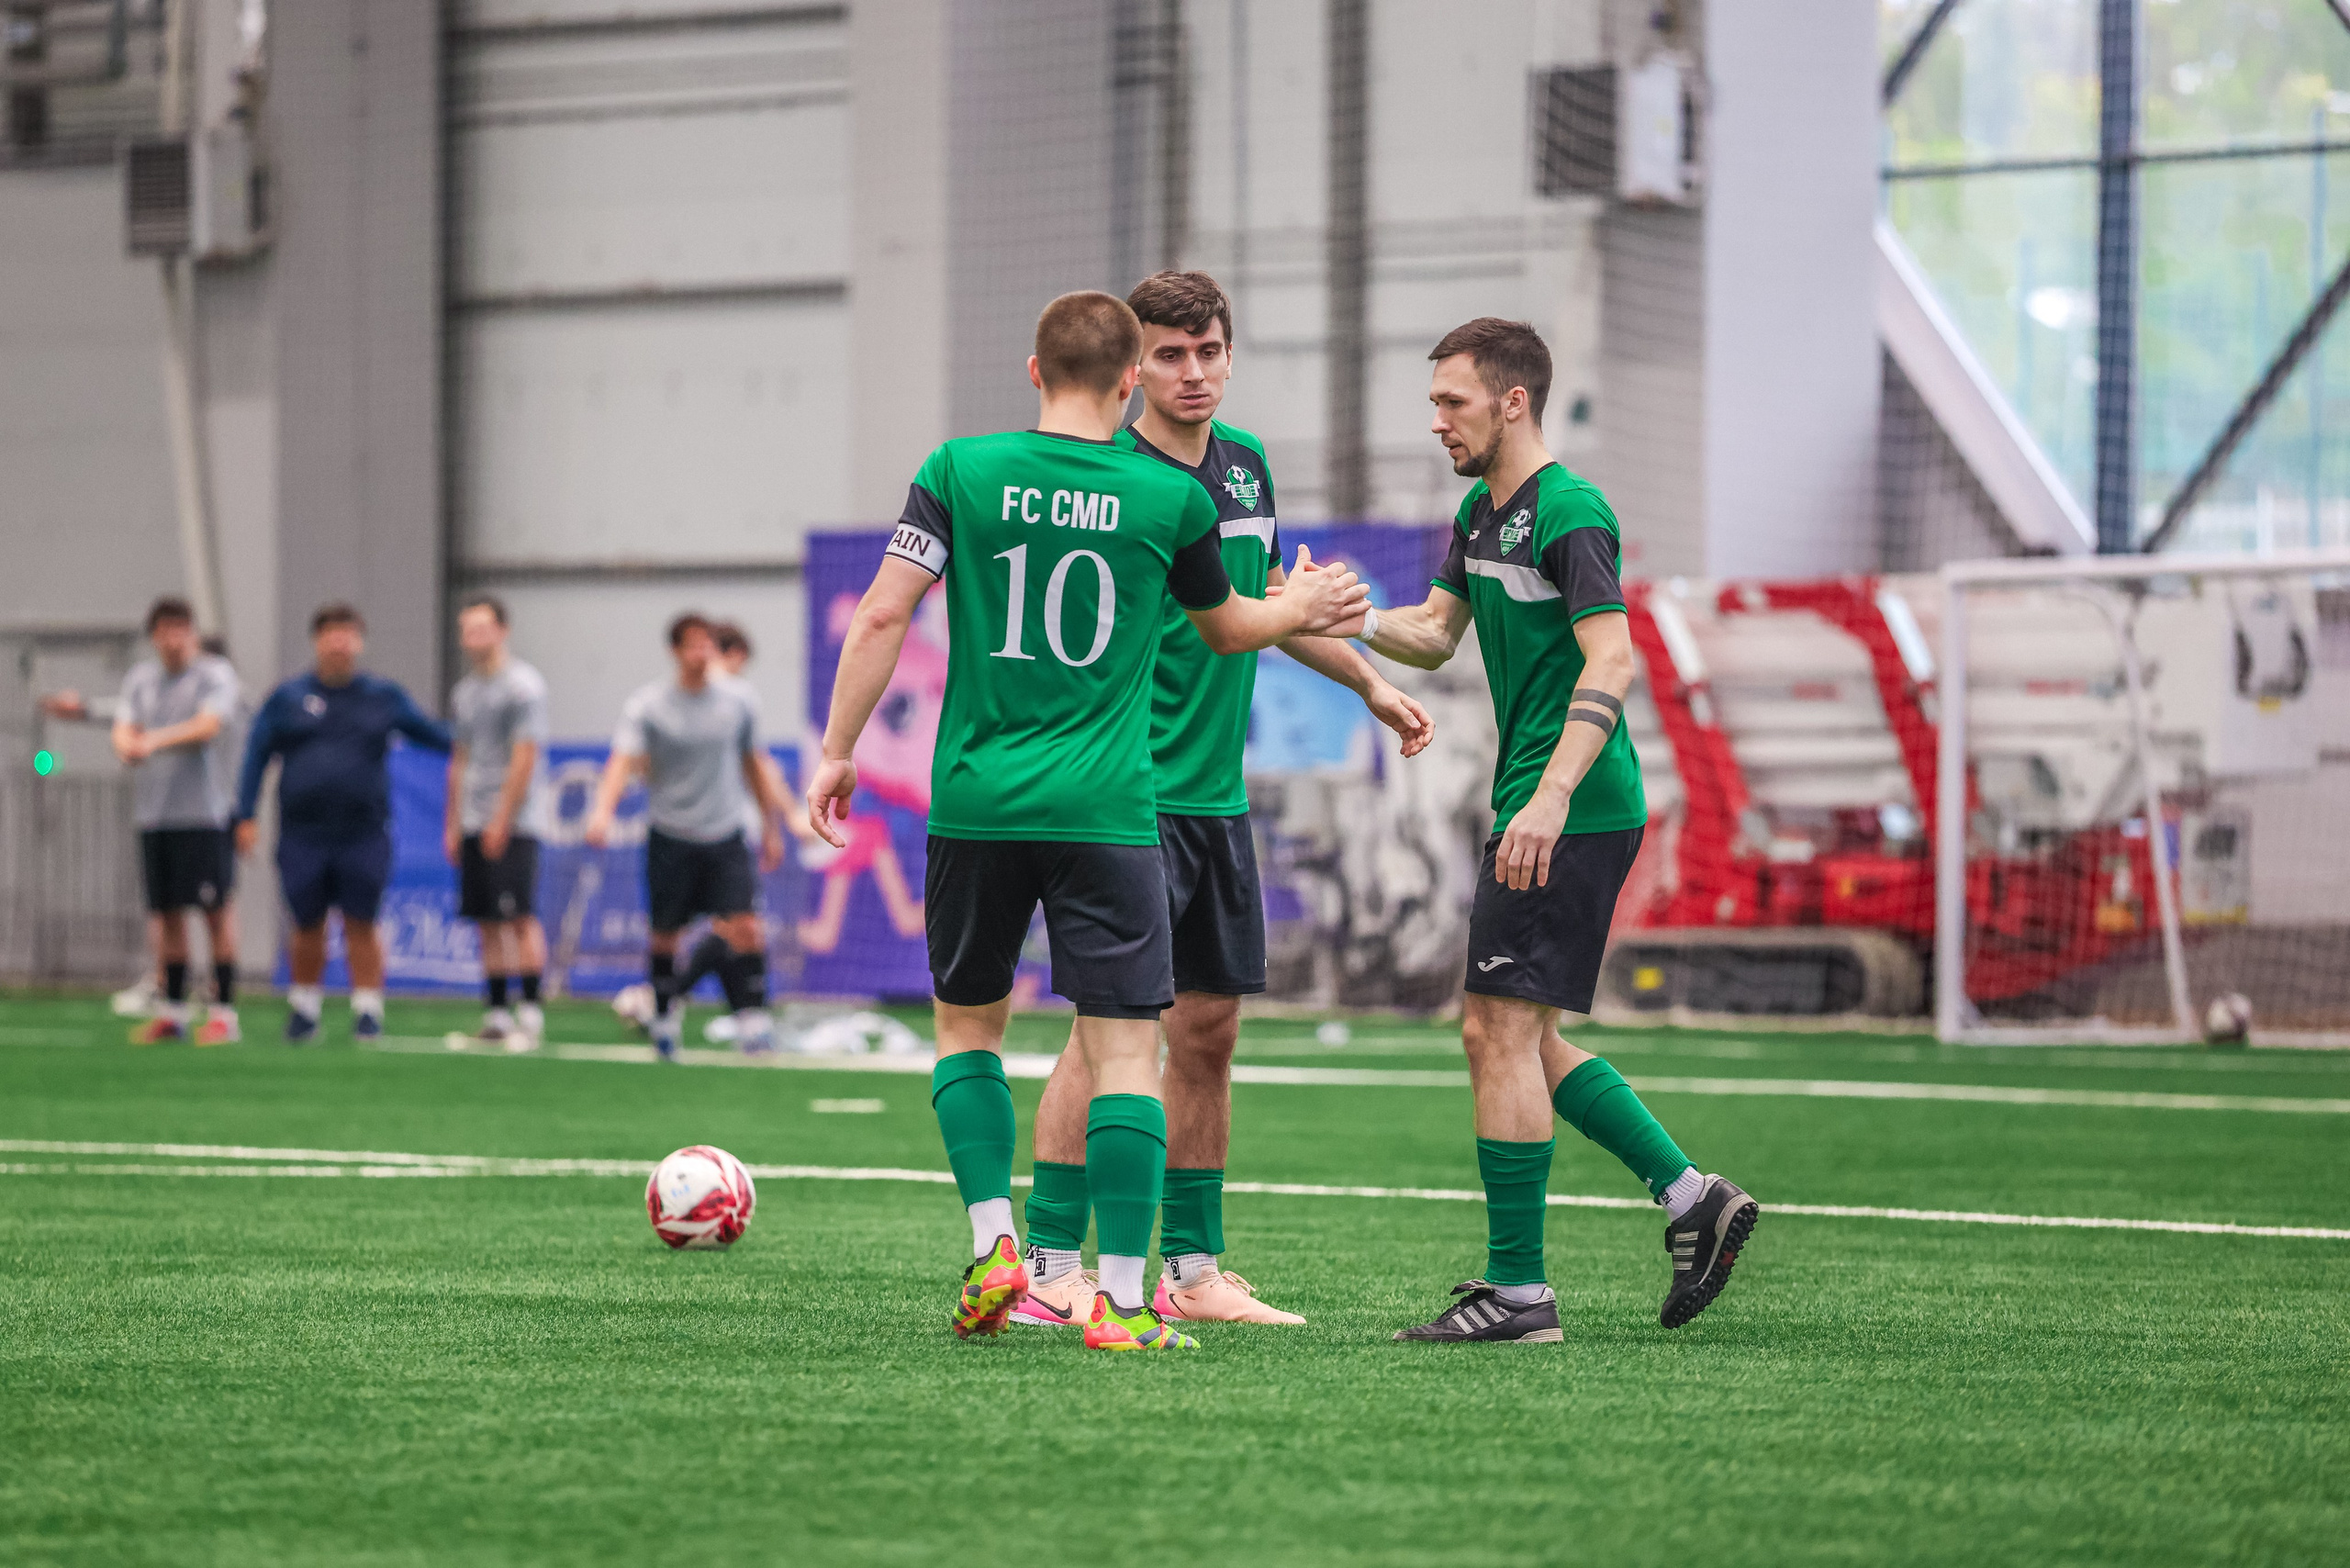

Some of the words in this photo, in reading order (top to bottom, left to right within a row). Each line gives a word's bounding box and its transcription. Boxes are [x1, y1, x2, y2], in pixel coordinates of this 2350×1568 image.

[1002, 486, 1043, 524] FC
[1050, 488, 1120, 532] CMD
[890, 530, 932, 557] AIN
[990, 543, 1116, 667] 10
